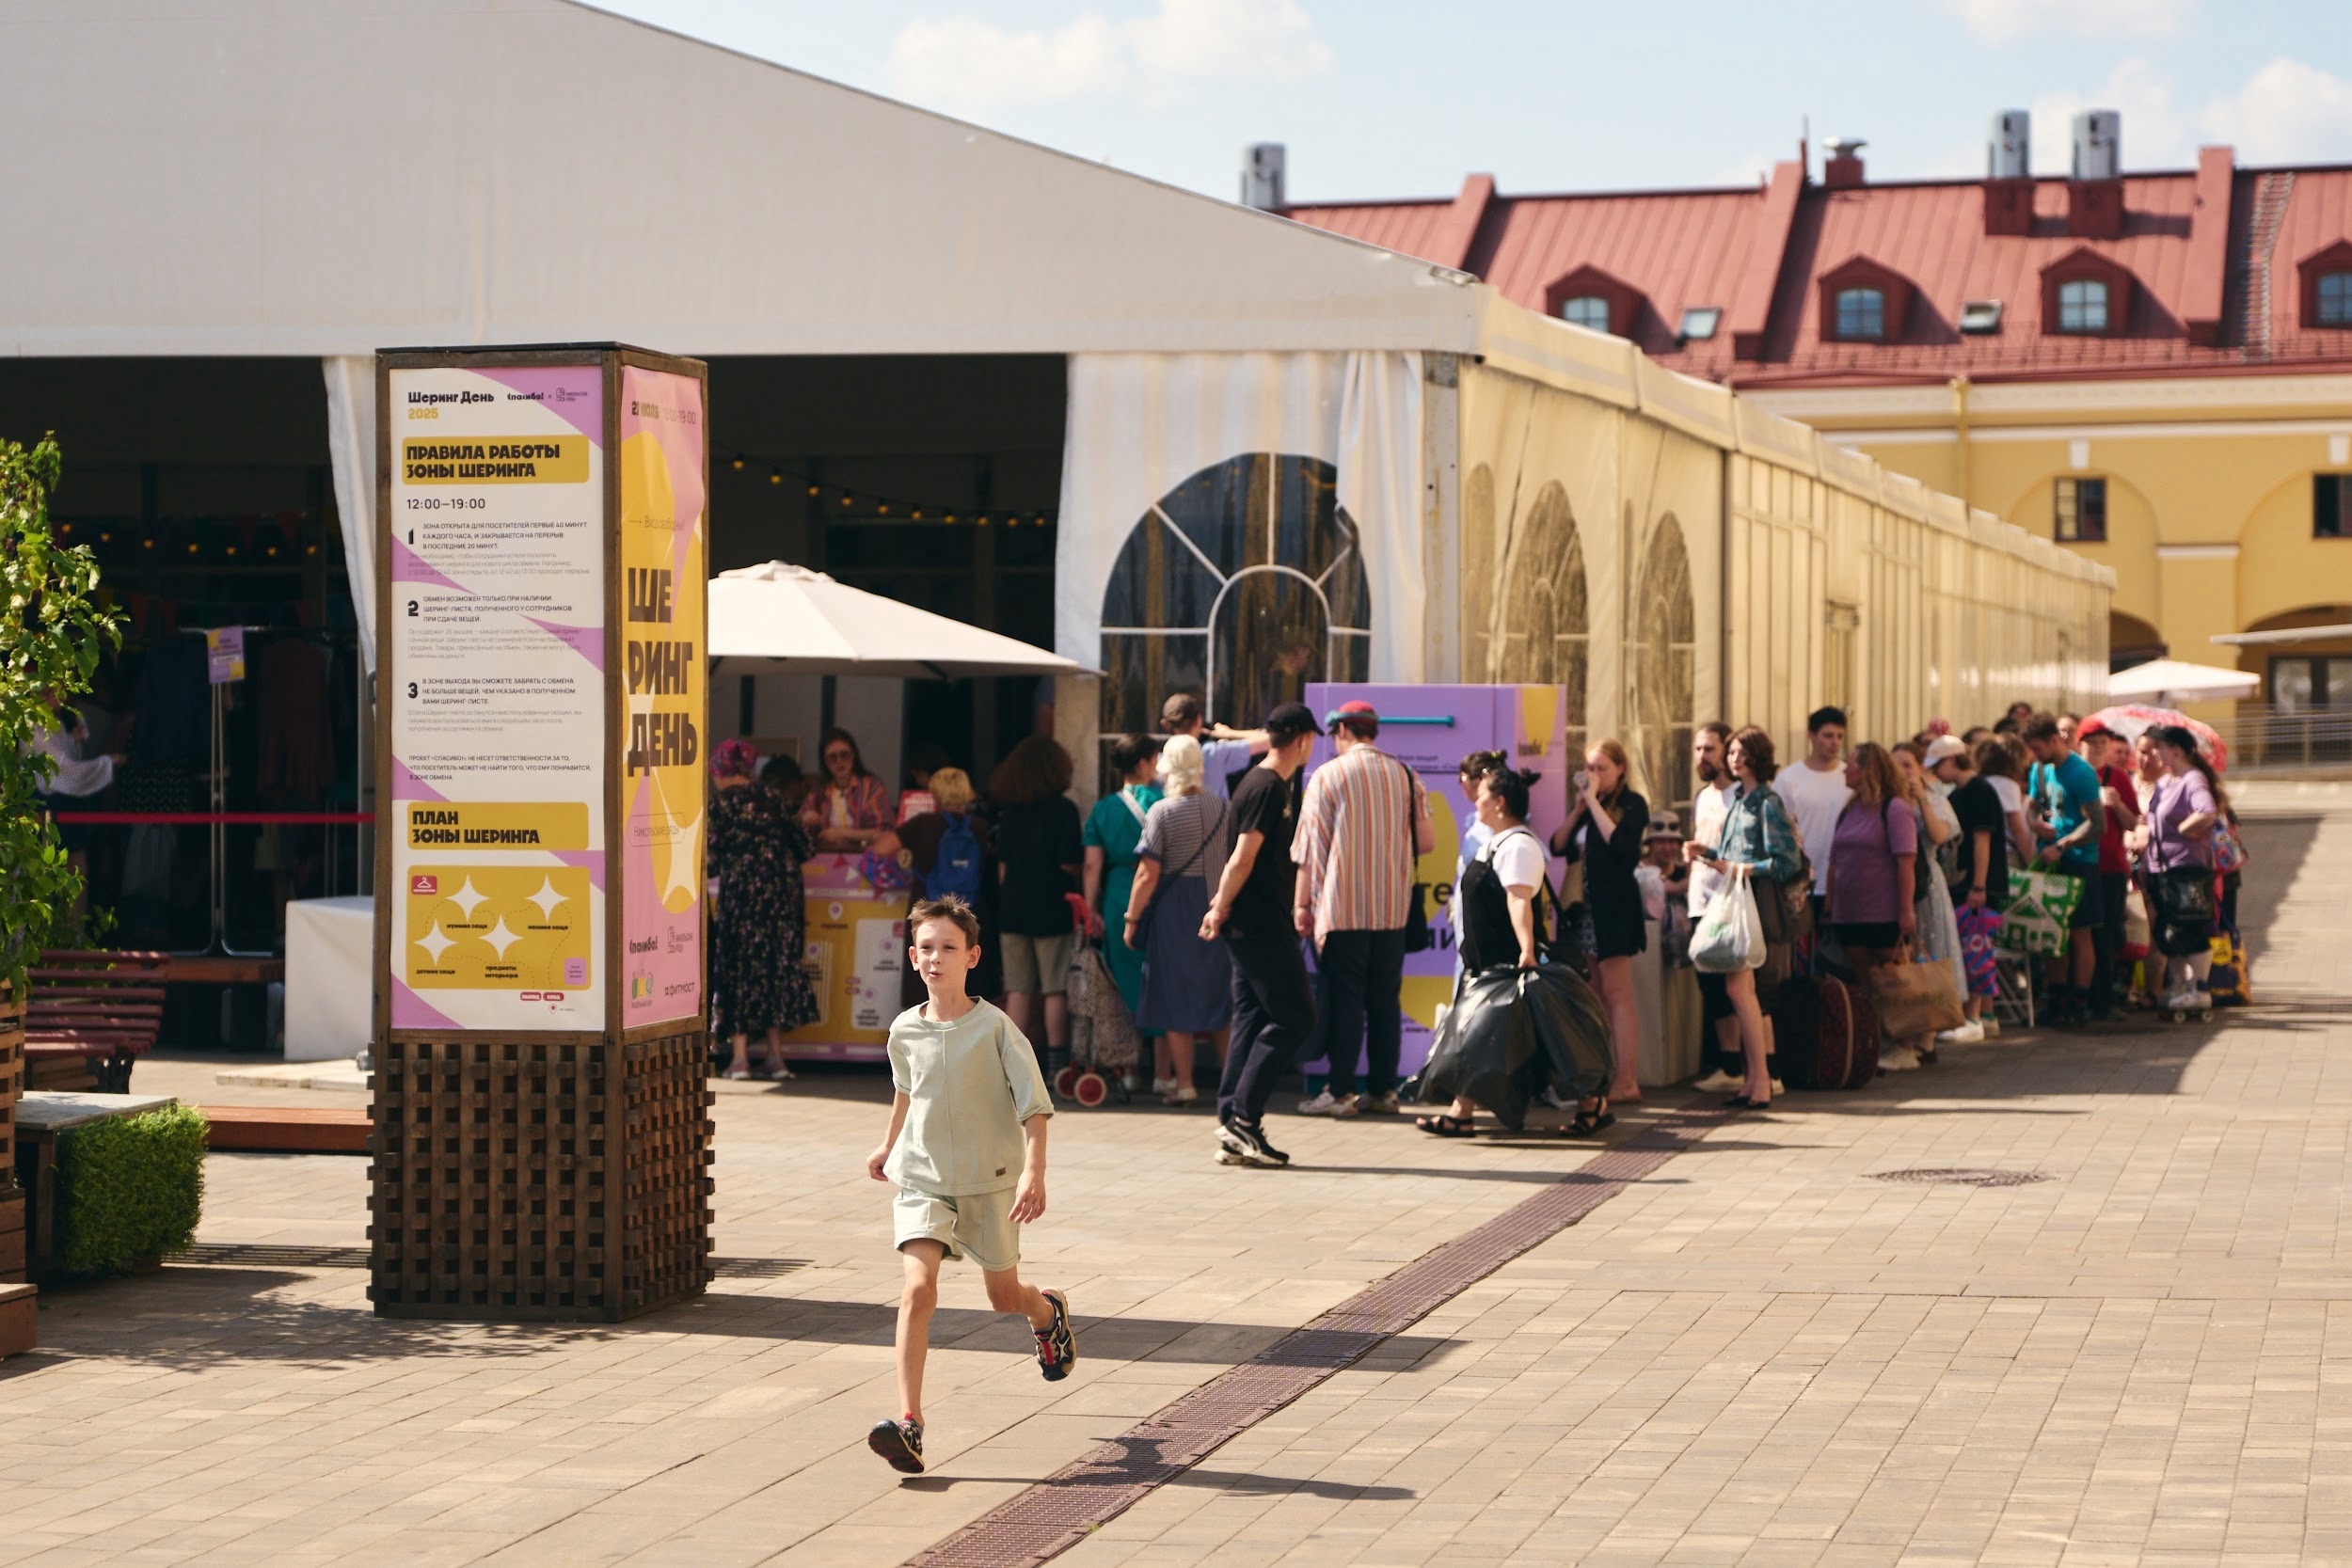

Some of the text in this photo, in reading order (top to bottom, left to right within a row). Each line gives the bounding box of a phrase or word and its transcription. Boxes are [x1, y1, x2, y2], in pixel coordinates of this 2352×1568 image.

[408, 391, 494, 405] Шеринг День
[408, 407, 438, 419] 2025
[407, 443, 560, 460] ПРАВИЛА РАБОТЫ
[406, 463, 536, 478] ЗОНЫ ШЕРИНГА
[408, 528, 414, 545] 1
[628, 567, 672, 623] ШЕ
[407, 600, 419, 617] 2
[628, 640, 693, 695] РИНГ
[407, 682, 418, 699] 3
[627, 713, 698, 777] ДЕНЬ
[412, 811, 458, 825] ПЛАН
[412, 829, 540, 843] ЗОНЫ ШЕРИНГА
